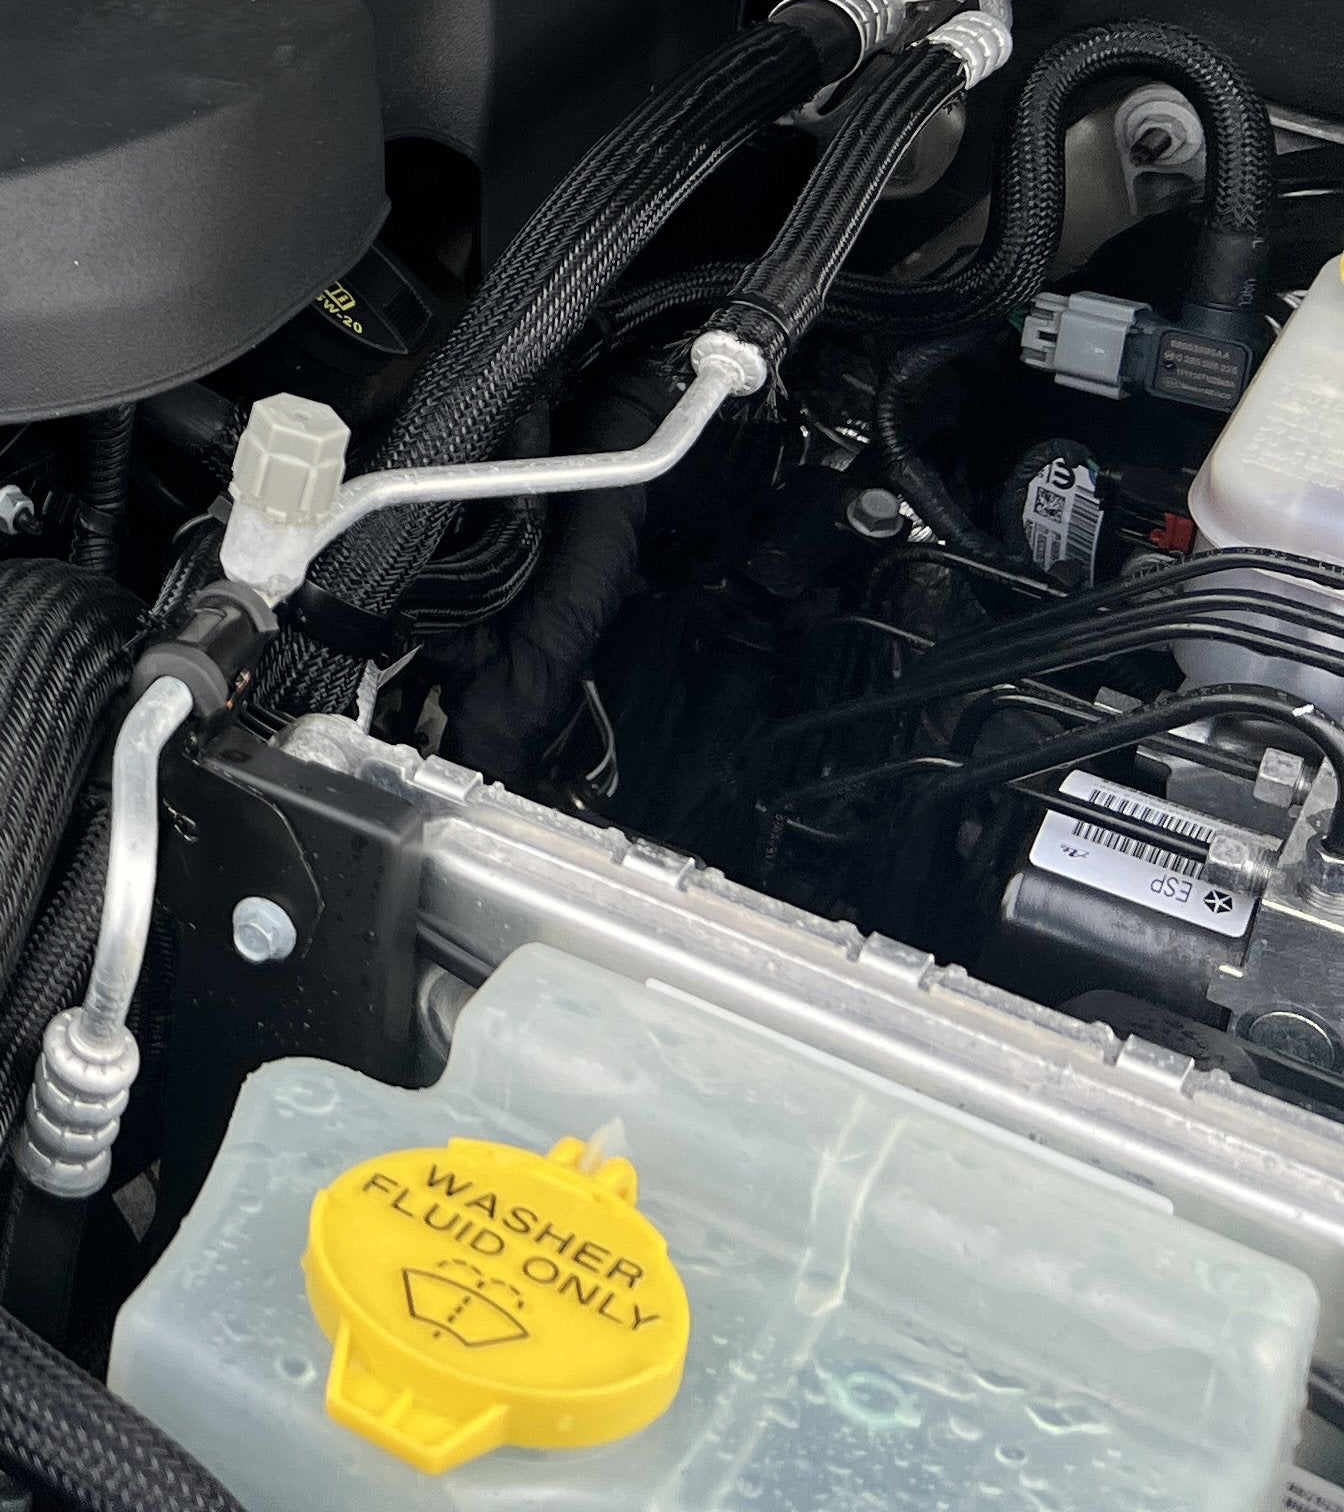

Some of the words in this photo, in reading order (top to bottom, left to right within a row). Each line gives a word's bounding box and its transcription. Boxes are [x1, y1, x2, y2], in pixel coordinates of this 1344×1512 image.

[1151, 875, 1194, 903] ESP
[362, 1173, 505, 1257] FLUID
[522, 1256, 661, 1332] ONLY
[425, 1163, 644, 1289] WASHER
